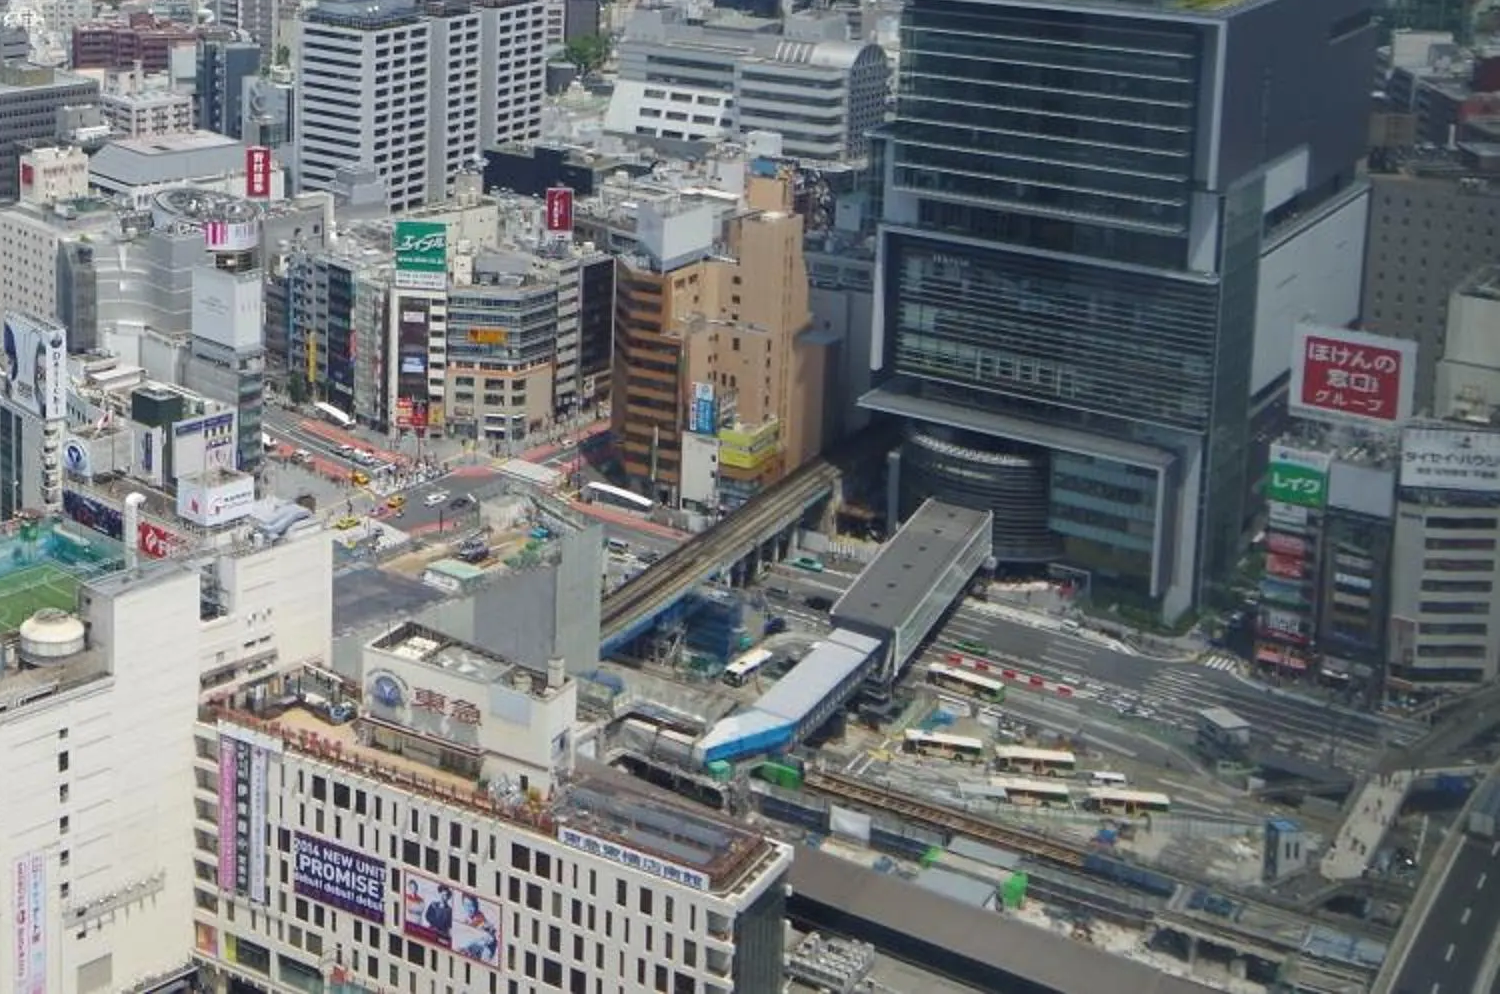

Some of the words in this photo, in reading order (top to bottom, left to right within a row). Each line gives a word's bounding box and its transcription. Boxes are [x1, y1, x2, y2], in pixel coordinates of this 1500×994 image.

[1308, 342, 1398, 374] ほけんの
[1315, 389, 1385, 412] グループ
[1273, 471, 1320, 494] レイク
[323, 848, 354, 869] NEW
